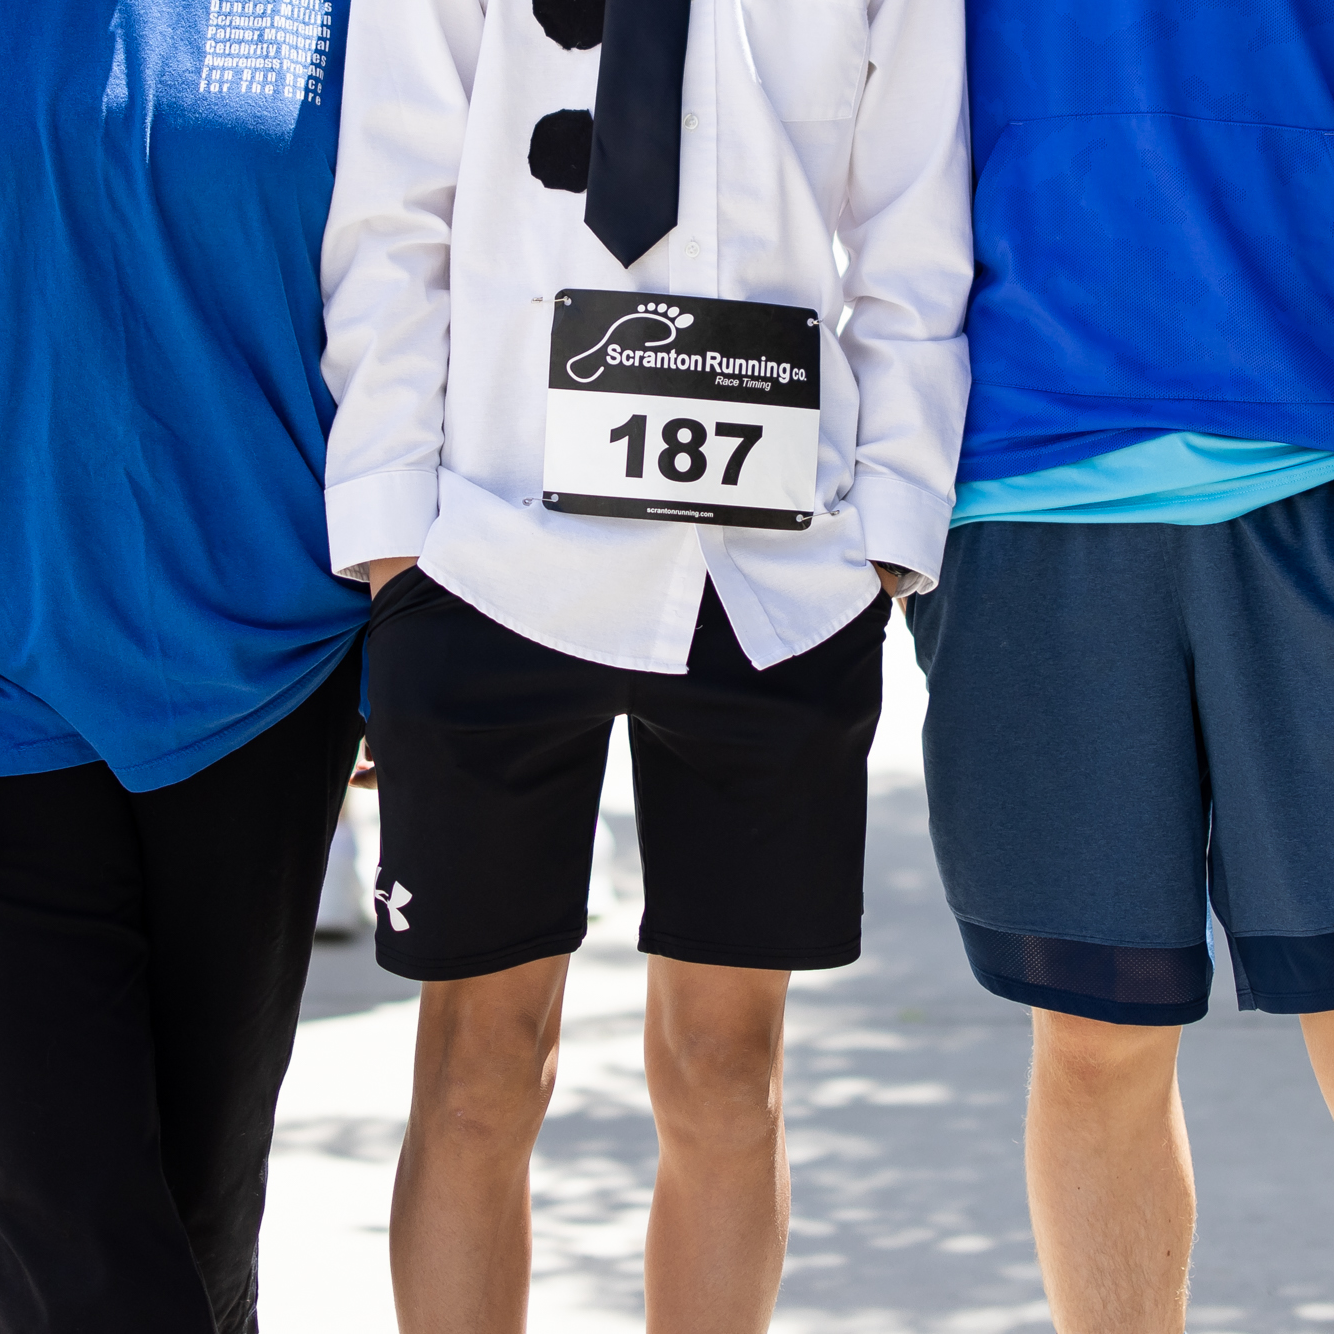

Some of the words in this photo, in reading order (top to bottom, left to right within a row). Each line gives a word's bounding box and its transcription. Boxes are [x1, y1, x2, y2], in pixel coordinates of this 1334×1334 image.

[208, 12, 272, 27] Scranton
[274, 15, 331, 39] Meredith
[280, 3, 332, 26] Mifflin
[207, 26, 261, 40] Palmer
[264, 28, 330, 52] Memorial
[205, 40, 277, 56] Celebrity
[281, 43, 327, 67] Rabies
[201, 67, 234, 81] Fun
[242, 68, 276, 83] Run
[285, 72, 323, 94] Race
[203, 54, 280, 69] Awareness
[282, 58, 325, 81] Pro-Am
[199, 80, 231, 93] For
[240, 81, 275, 95] The
[283, 85, 322, 106] Cure
[605, 343, 703, 372] Scranton
[705, 351, 791, 384] Running
[714, 375, 740, 387] Race
[742, 377, 772, 392] Timing
[608, 413, 764, 487] 187
[646, 507, 714, 518] scrantonrunning.com
